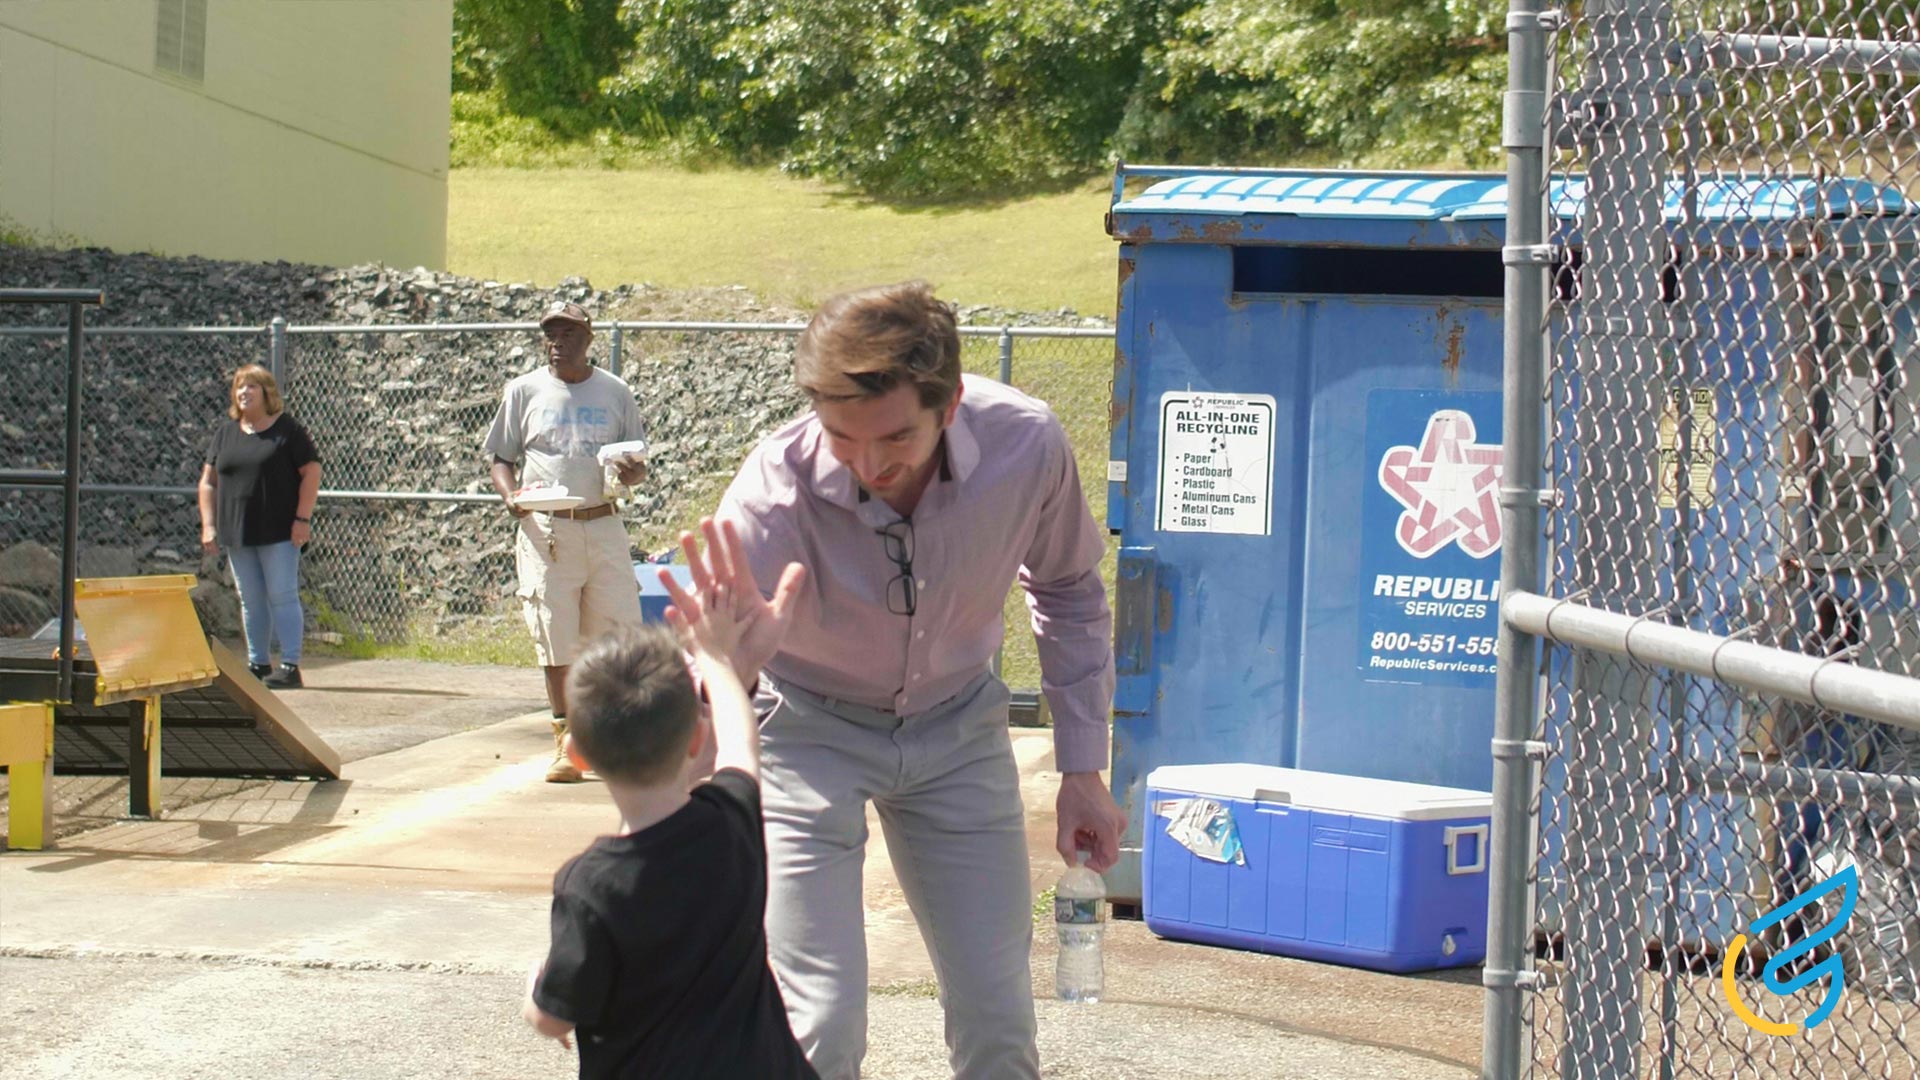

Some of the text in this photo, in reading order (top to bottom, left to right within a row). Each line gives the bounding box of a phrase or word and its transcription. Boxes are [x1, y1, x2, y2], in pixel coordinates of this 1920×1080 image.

[1176, 411, 1260, 423] ALL-IN-ONE
[1177, 423, 1258, 435] RECYCLING
[1183, 453, 1211, 464] Paper
[1183, 465, 1232, 477] Cardboard
[1182, 478, 1215, 489] Plastic
[1182, 491, 1256, 504] Aluminum Cans
[1181, 503, 1235, 515] Metal Cans
[1181, 516, 1207, 527] Glass
[1373, 574, 1500, 601] REPUBLI
[1404, 601, 1486, 618] SERVICES
